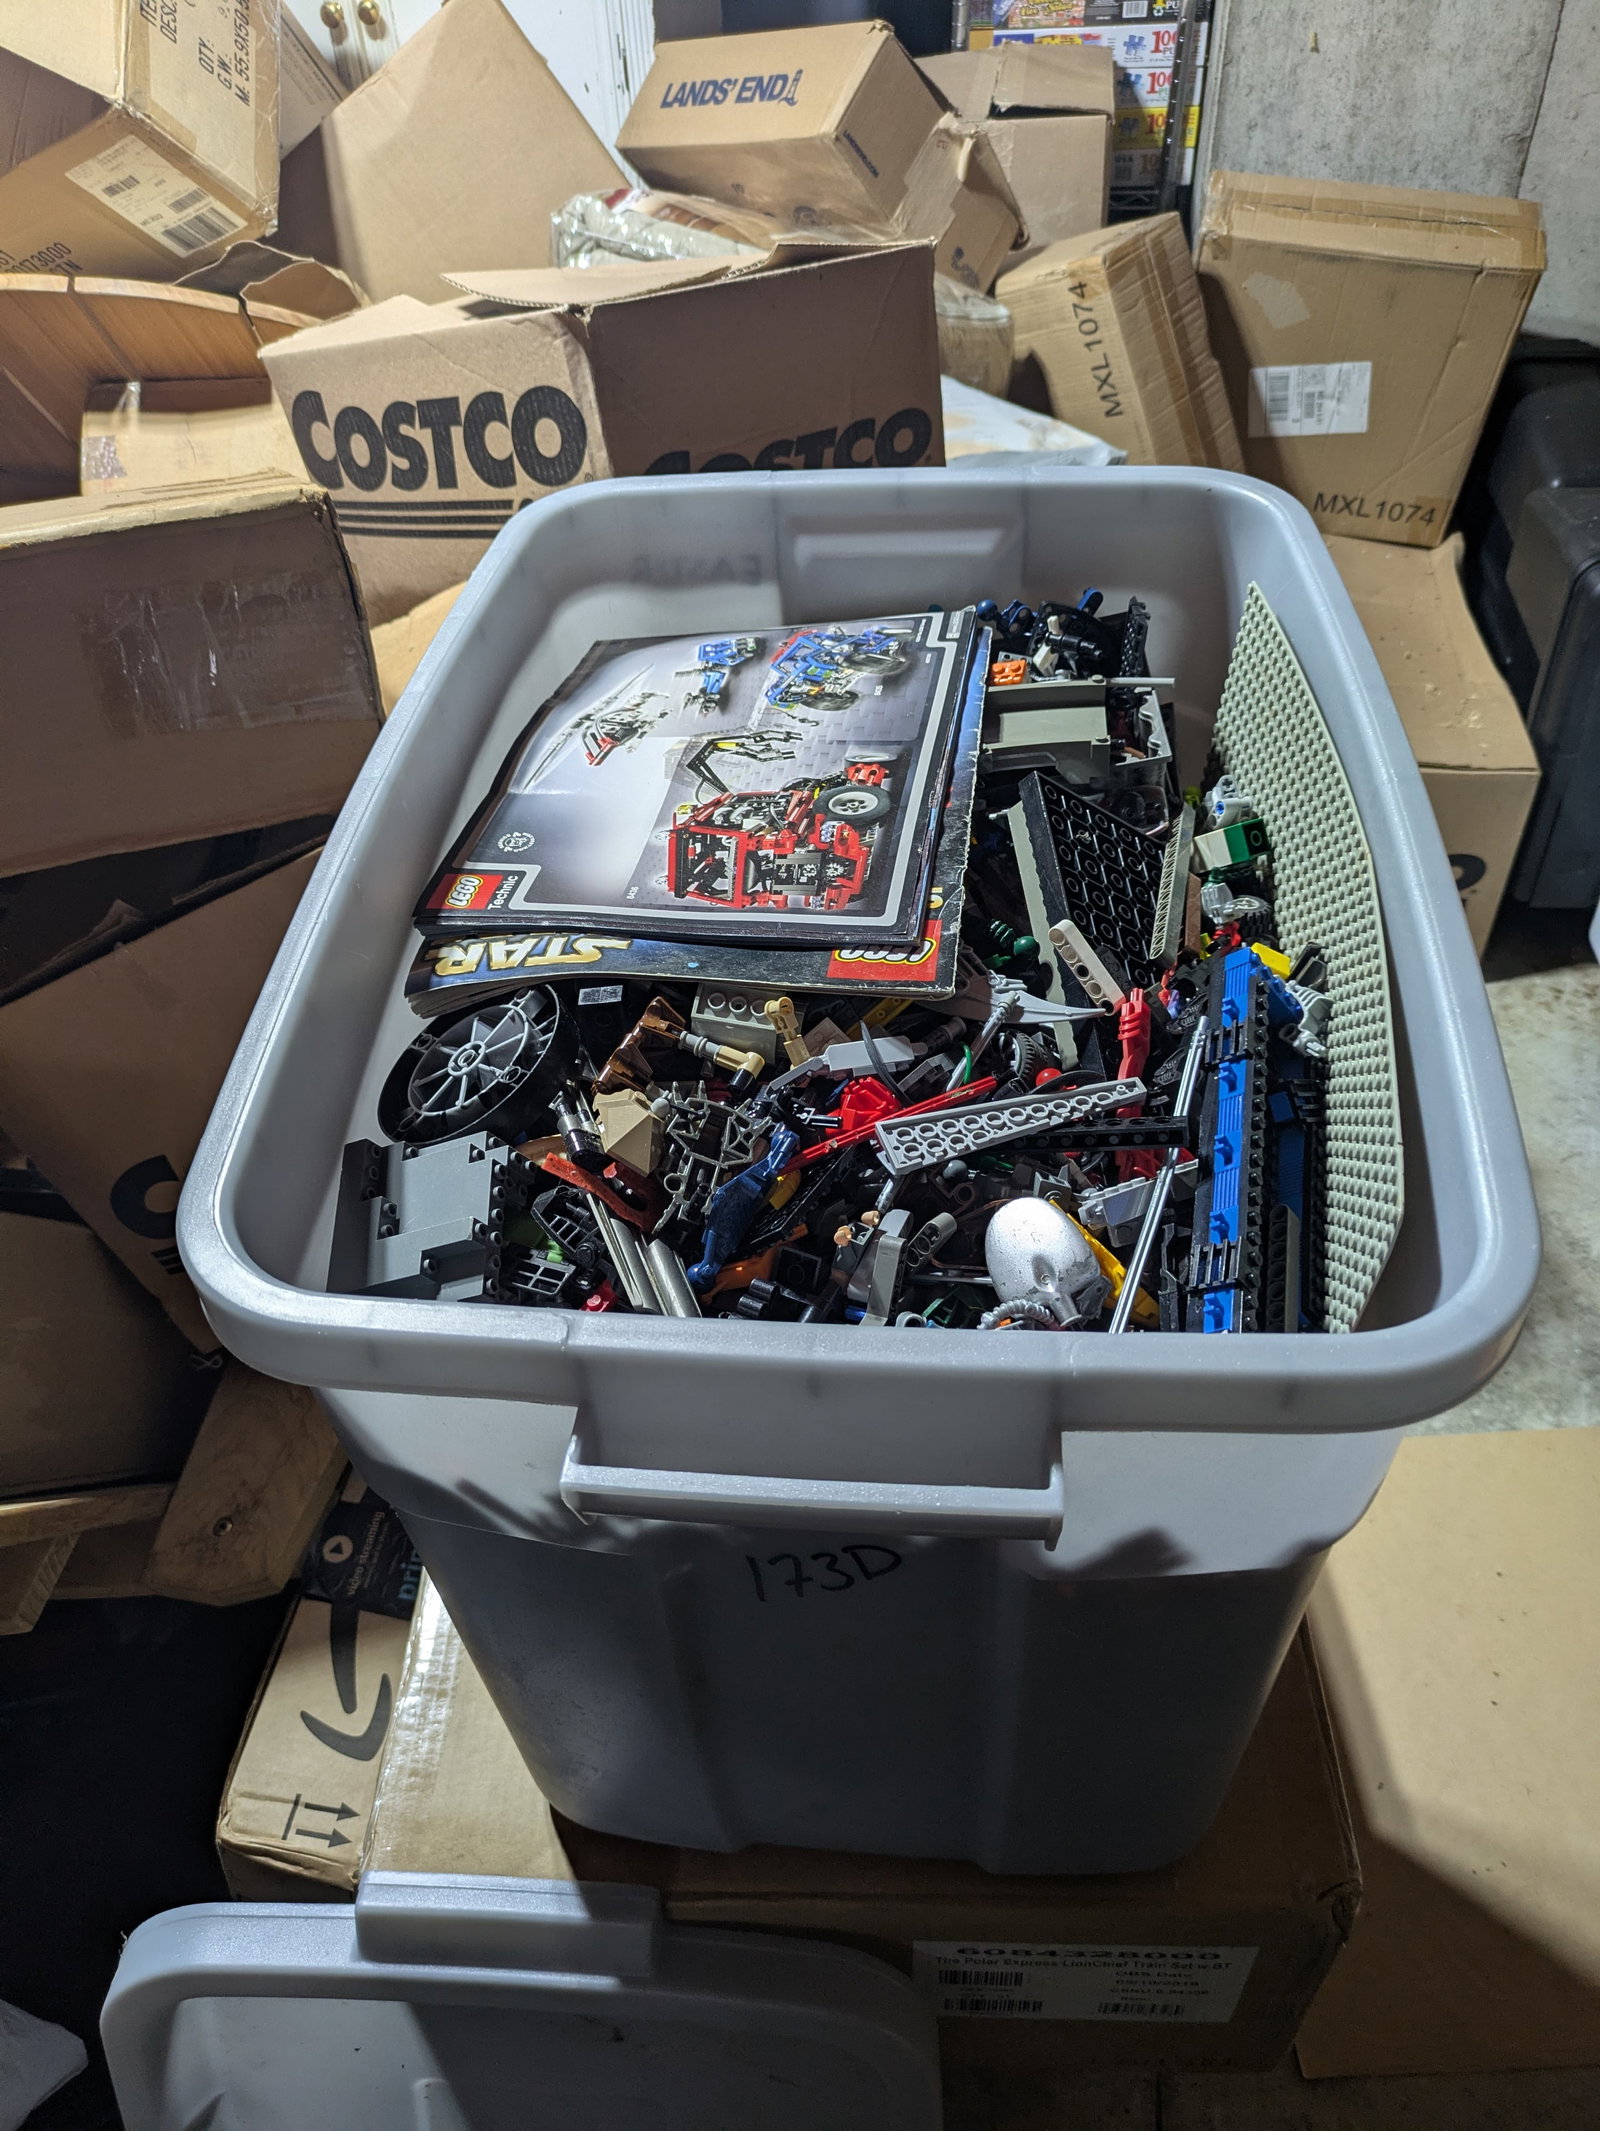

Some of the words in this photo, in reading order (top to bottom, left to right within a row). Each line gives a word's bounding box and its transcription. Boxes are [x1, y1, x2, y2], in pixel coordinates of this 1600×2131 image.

[139, 0, 158, 27] ITE
[198, 36, 215, 75] QTY:
[660, 76, 737, 109] LANDS'
[734, 73, 786, 105] END
[291, 385, 588, 492] COSTCO
[447, 876, 481, 908] LEGO
[487, 875, 519, 910] Technic
[432, 935, 632, 977] STAR
[359, 1511, 386, 1564] streaming
[746, 1544, 903, 1602] 173D
[935, 1956, 961, 1965] The
[964, 1957, 1000, 1966] Polar
[1003, 1958, 1058, 1968] Express
[1133, 1961, 1167, 1969] Train
[1170, 1962, 1193, 1970] Set
